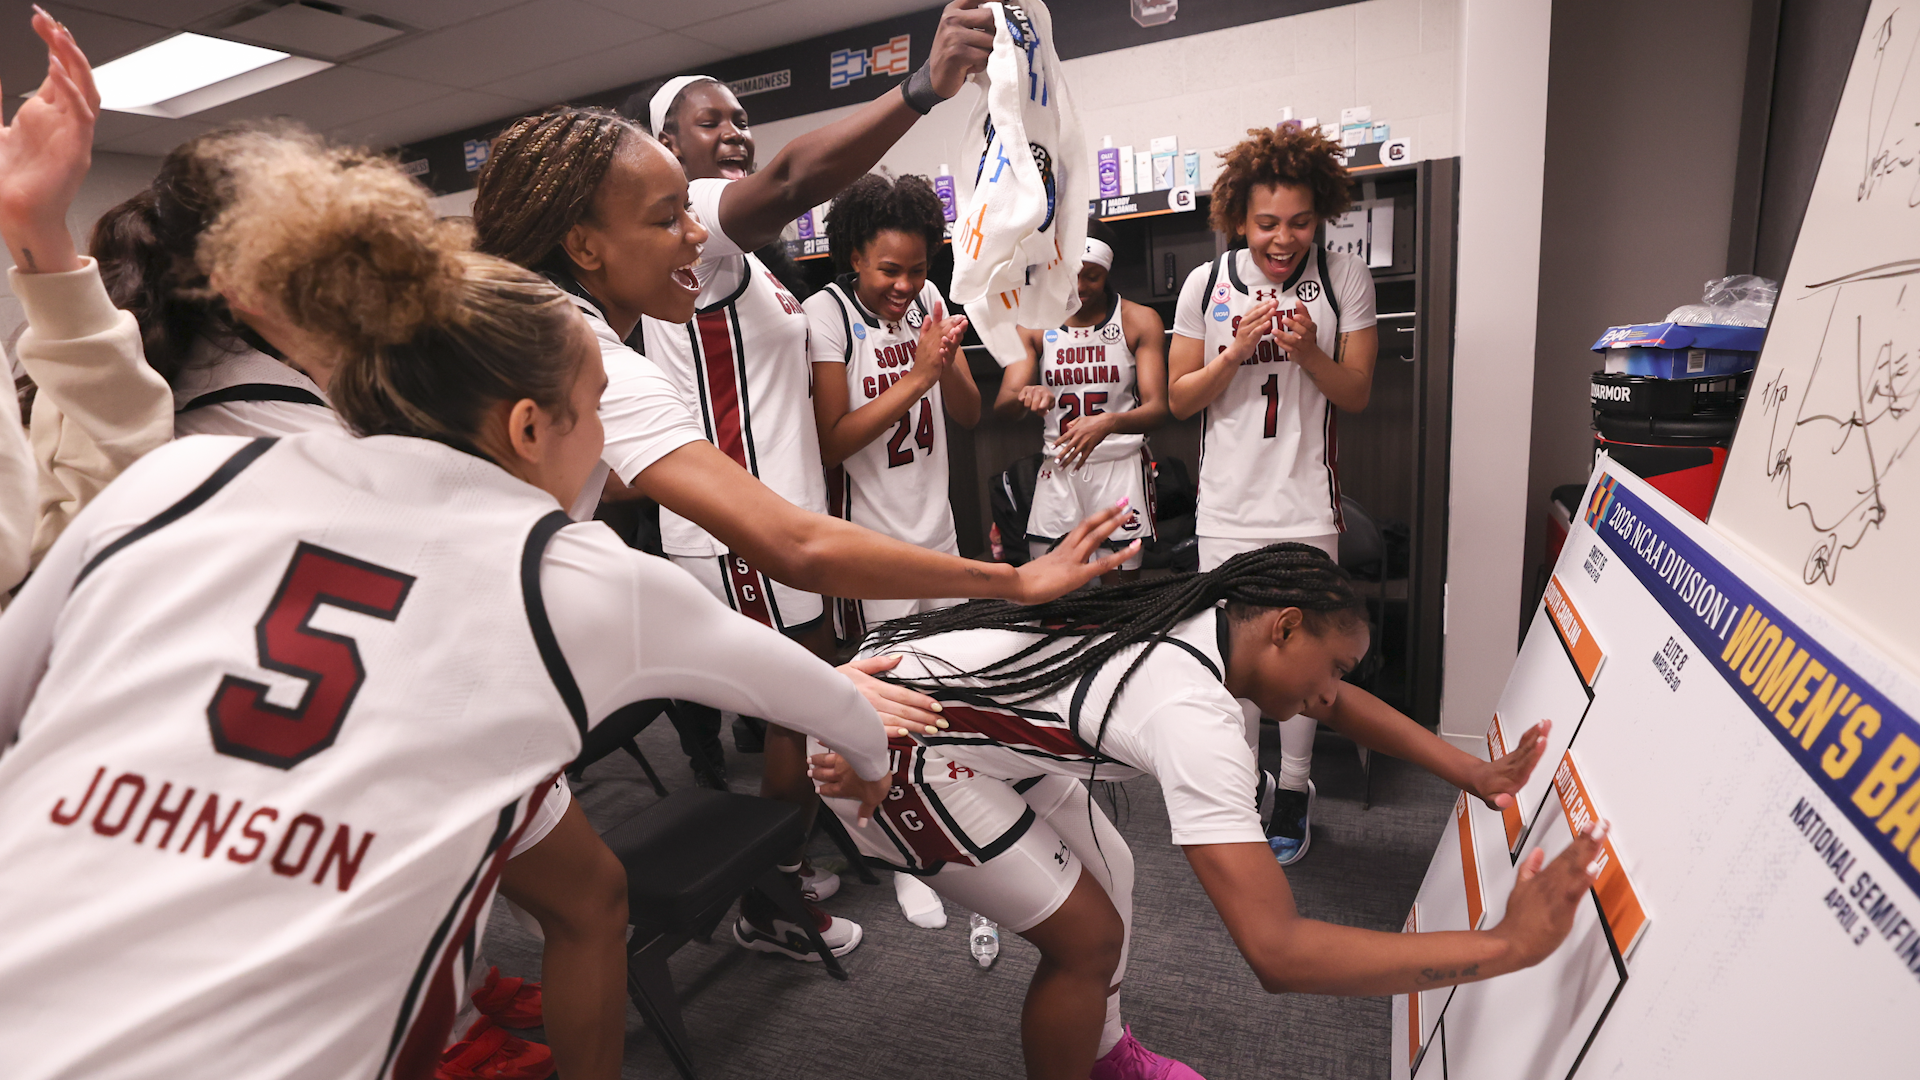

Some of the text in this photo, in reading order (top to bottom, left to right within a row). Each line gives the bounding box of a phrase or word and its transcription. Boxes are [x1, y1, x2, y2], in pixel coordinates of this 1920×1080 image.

[1101, 199, 1107, 216] 1
[803, 239, 815, 254] 21
[1299, 282, 1319, 301] SEC
[1104, 324, 1120, 339] SEC
[1045, 365, 1120, 387] CAROLINA
[1056, 345, 1106, 365] SOUTH
[1261, 373, 1279, 439] 1
[1608, 502, 1637, 541] 2026
[1629, 520, 1666, 571] NCAA
[1658, 547, 1730, 631] DIVISION
[1544, 580, 1583, 649] SOUTH CAROLINA
[1718, 605, 1740, 641] I
[206, 539, 418, 771] 5
[1652, 650, 1681, 692] MARCH 29-30
[1663, 635, 1689, 672] ELITE 8
[1721, 603, 1882, 781] WOMEN'S
[50, 766, 376, 893] JOHNSON
[1555, 759, 1610, 880] SOUTH CARA
[1789, 796, 1920, 985] NATIONAL SEMIFIN
[1824, 887, 1870, 946] APRIL 3
